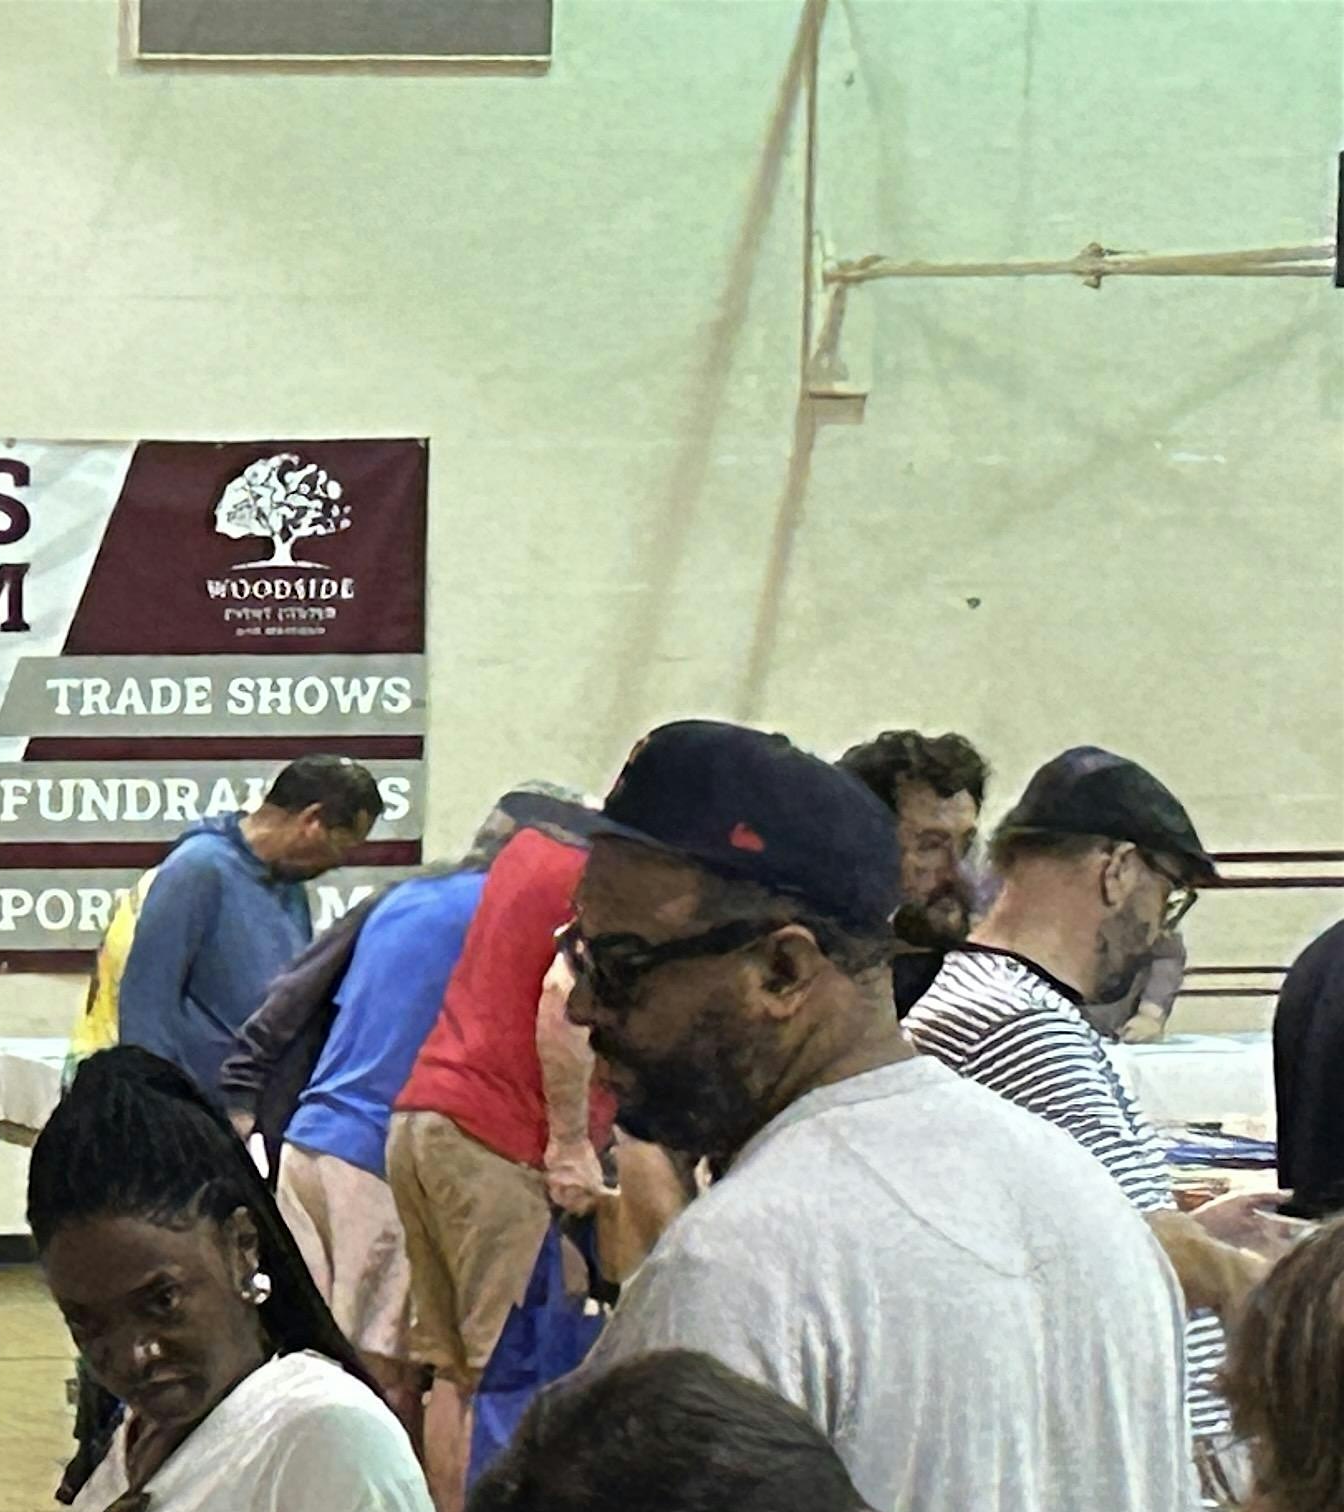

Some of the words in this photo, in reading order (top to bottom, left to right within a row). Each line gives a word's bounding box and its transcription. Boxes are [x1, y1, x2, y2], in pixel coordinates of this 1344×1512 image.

[206, 577, 355, 600] WOODSIDE
[47, 677, 212, 716] TRADE
[226, 676, 412, 715] SHOWS
